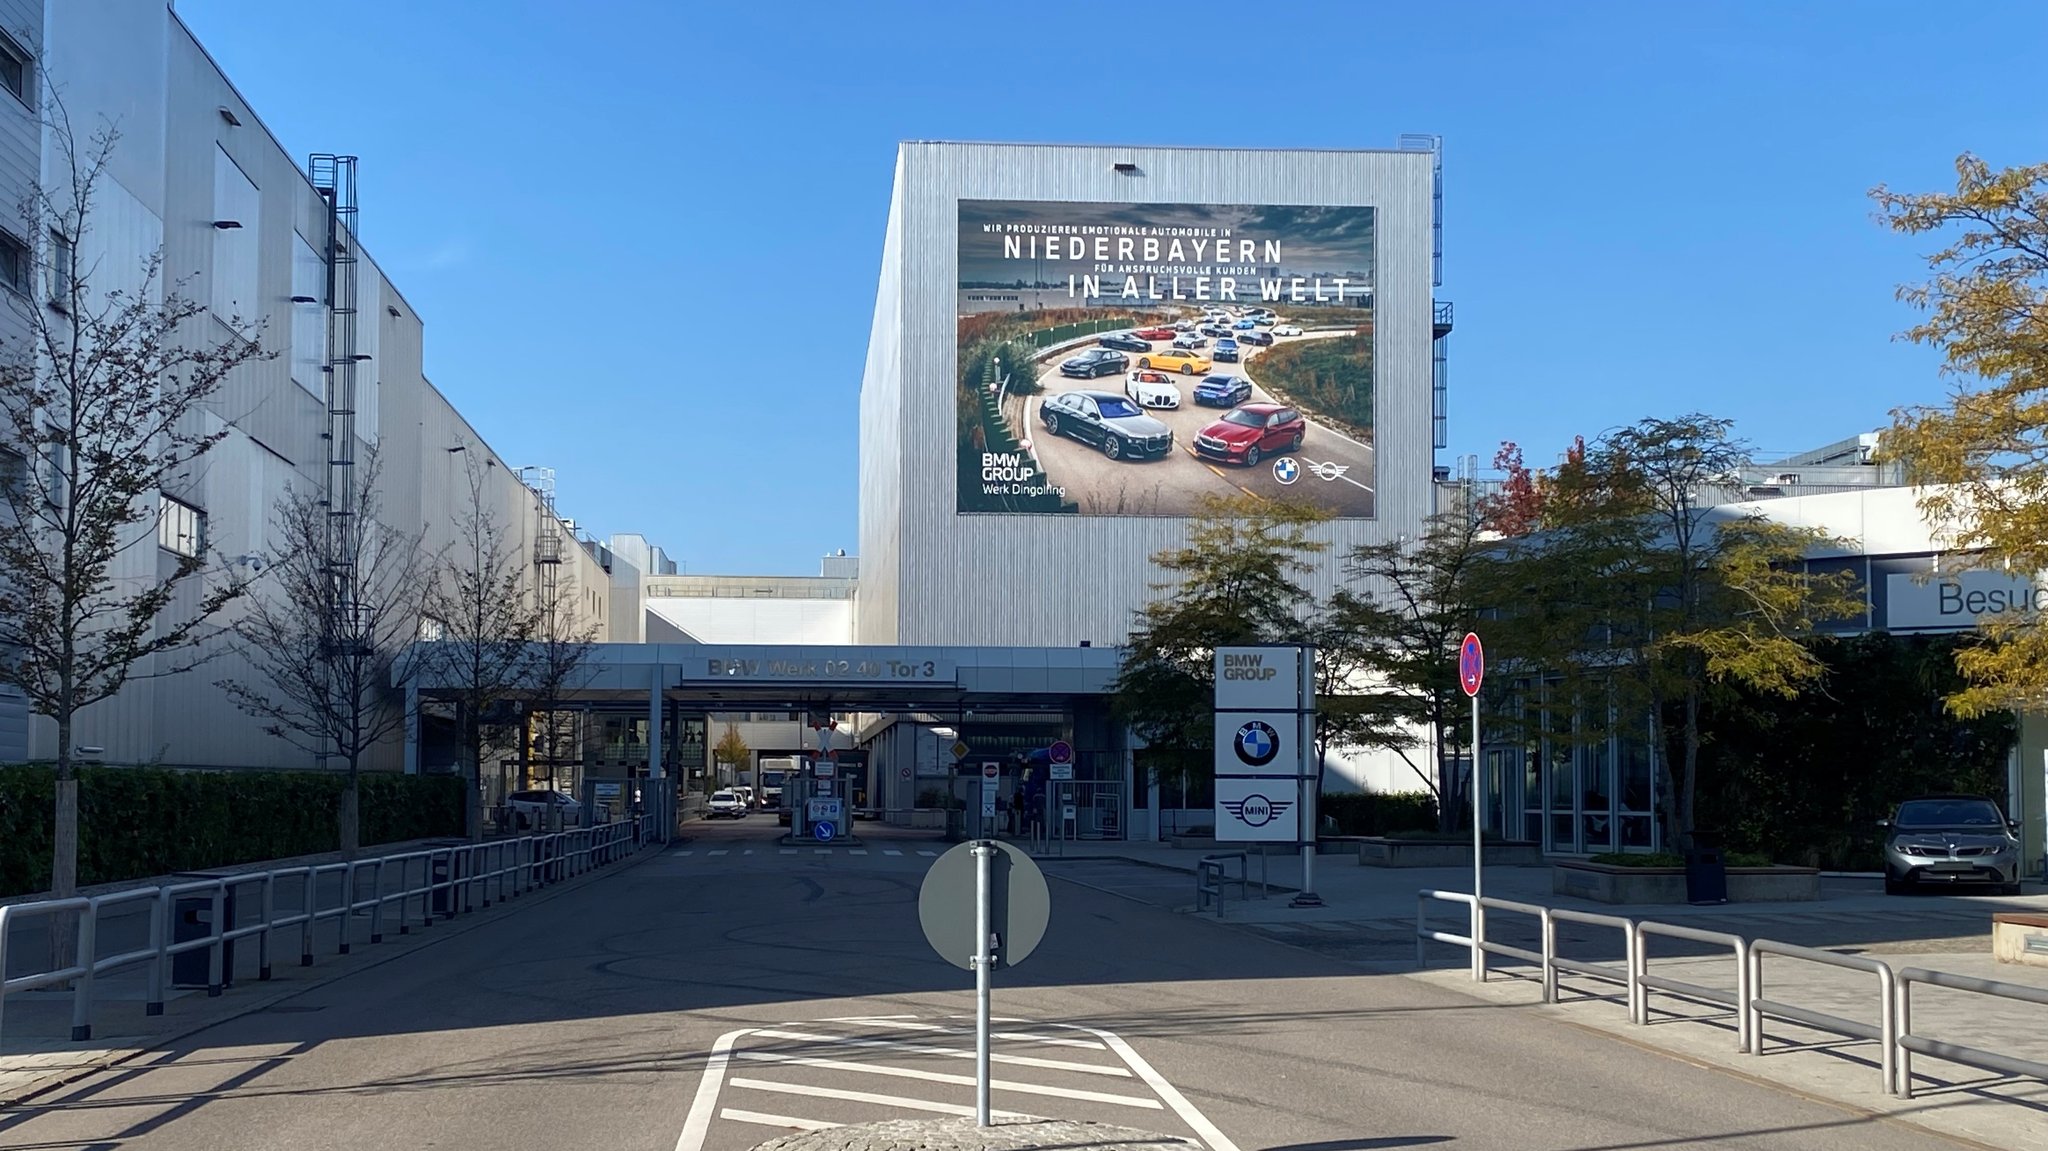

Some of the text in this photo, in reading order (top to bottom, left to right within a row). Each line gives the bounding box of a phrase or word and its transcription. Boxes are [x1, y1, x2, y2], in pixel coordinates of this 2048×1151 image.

[983, 224, 1231, 238] WIR PRODUZIEREN EMOTIONALE AUTOMOBILE IN
[1004, 235, 1281, 264] NIEDERBAYERN
[1094, 264, 1256, 276] FÜR ANSPRUCHSVOLLE KUNDEN
[1069, 274, 1350, 302] IN ALLER WELT
[982, 453, 1020, 467] BMW
[982, 467, 1034, 481] GROUP
[982, 484, 1066, 498] Werk Dingolfing
[708, 659, 760, 677] BMW
[768, 660, 818, 677] Werk
[887, 660, 919, 677] Tor
[923, 661, 936, 677] 3
[1224, 655, 1263, 667] BMW
[1224, 668, 1276, 681] GROUP
[1238, 722, 1275, 737] BMW
[1244, 806, 1269, 815] MINI
